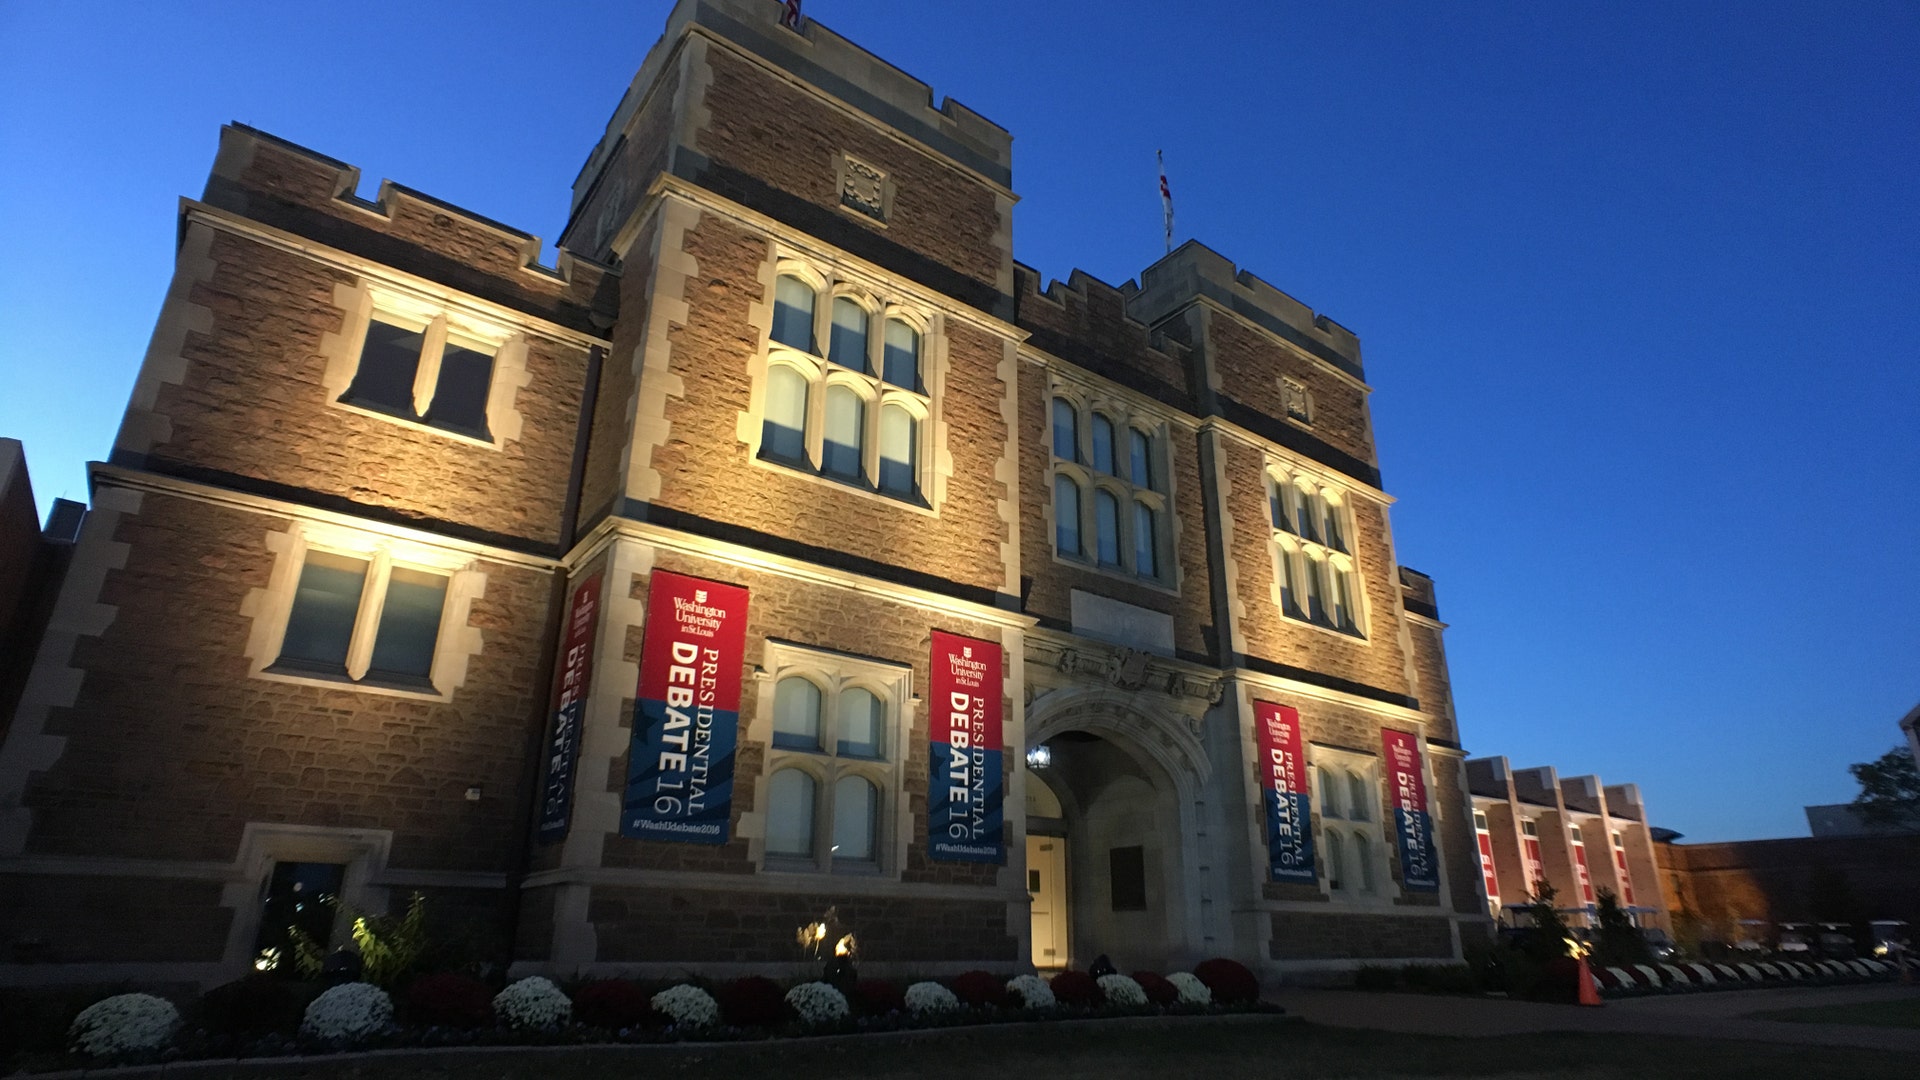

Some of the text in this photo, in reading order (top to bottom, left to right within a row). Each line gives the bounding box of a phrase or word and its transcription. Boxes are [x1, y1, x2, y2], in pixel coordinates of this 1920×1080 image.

[674, 597, 726, 618] Washington
[676, 609, 721, 631] University
[948, 653, 987, 671] Washington
[951, 664, 984, 682] University
[551, 646, 579, 774] DEBATE
[654, 641, 699, 815] DEBATE 16
[687, 648, 719, 815] PRESIDENTIAL
[949, 691, 970, 839] DEBATE 16
[972, 697, 985, 840] PRESIDENTIAL
[1271, 748, 1292, 837] DEBATE
[1284, 751, 1304, 865] PRESIDENTIAL
[1279, 839, 1294, 865] 16
[1397, 771, 1418, 850] DEBATE
